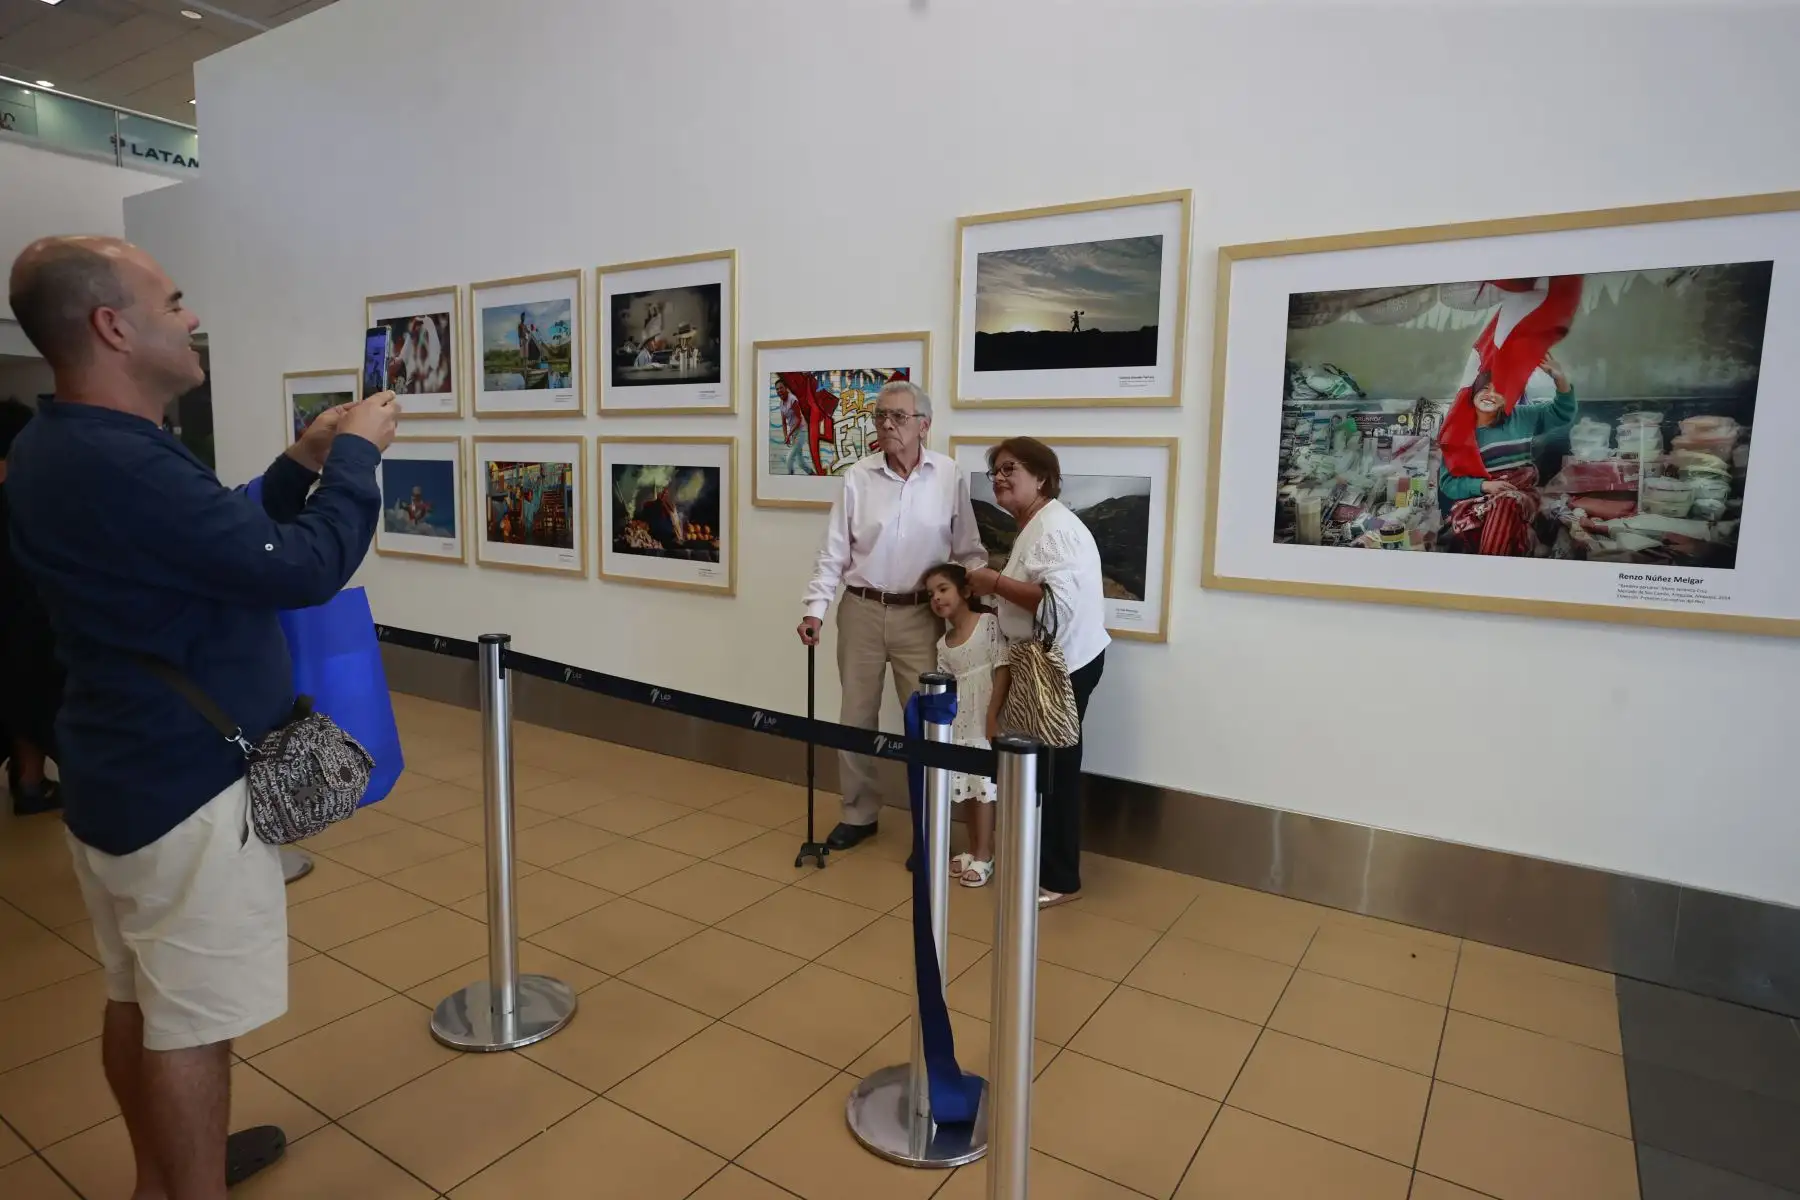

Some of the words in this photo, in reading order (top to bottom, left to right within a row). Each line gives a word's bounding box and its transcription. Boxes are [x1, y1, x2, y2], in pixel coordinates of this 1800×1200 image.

[1618, 572, 1643, 581] Renzo
[1645, 574, 1671, 583] Núñez
[1673, 576, 1704, 585] Melgar
[888, 740, 904, 750] LAP
